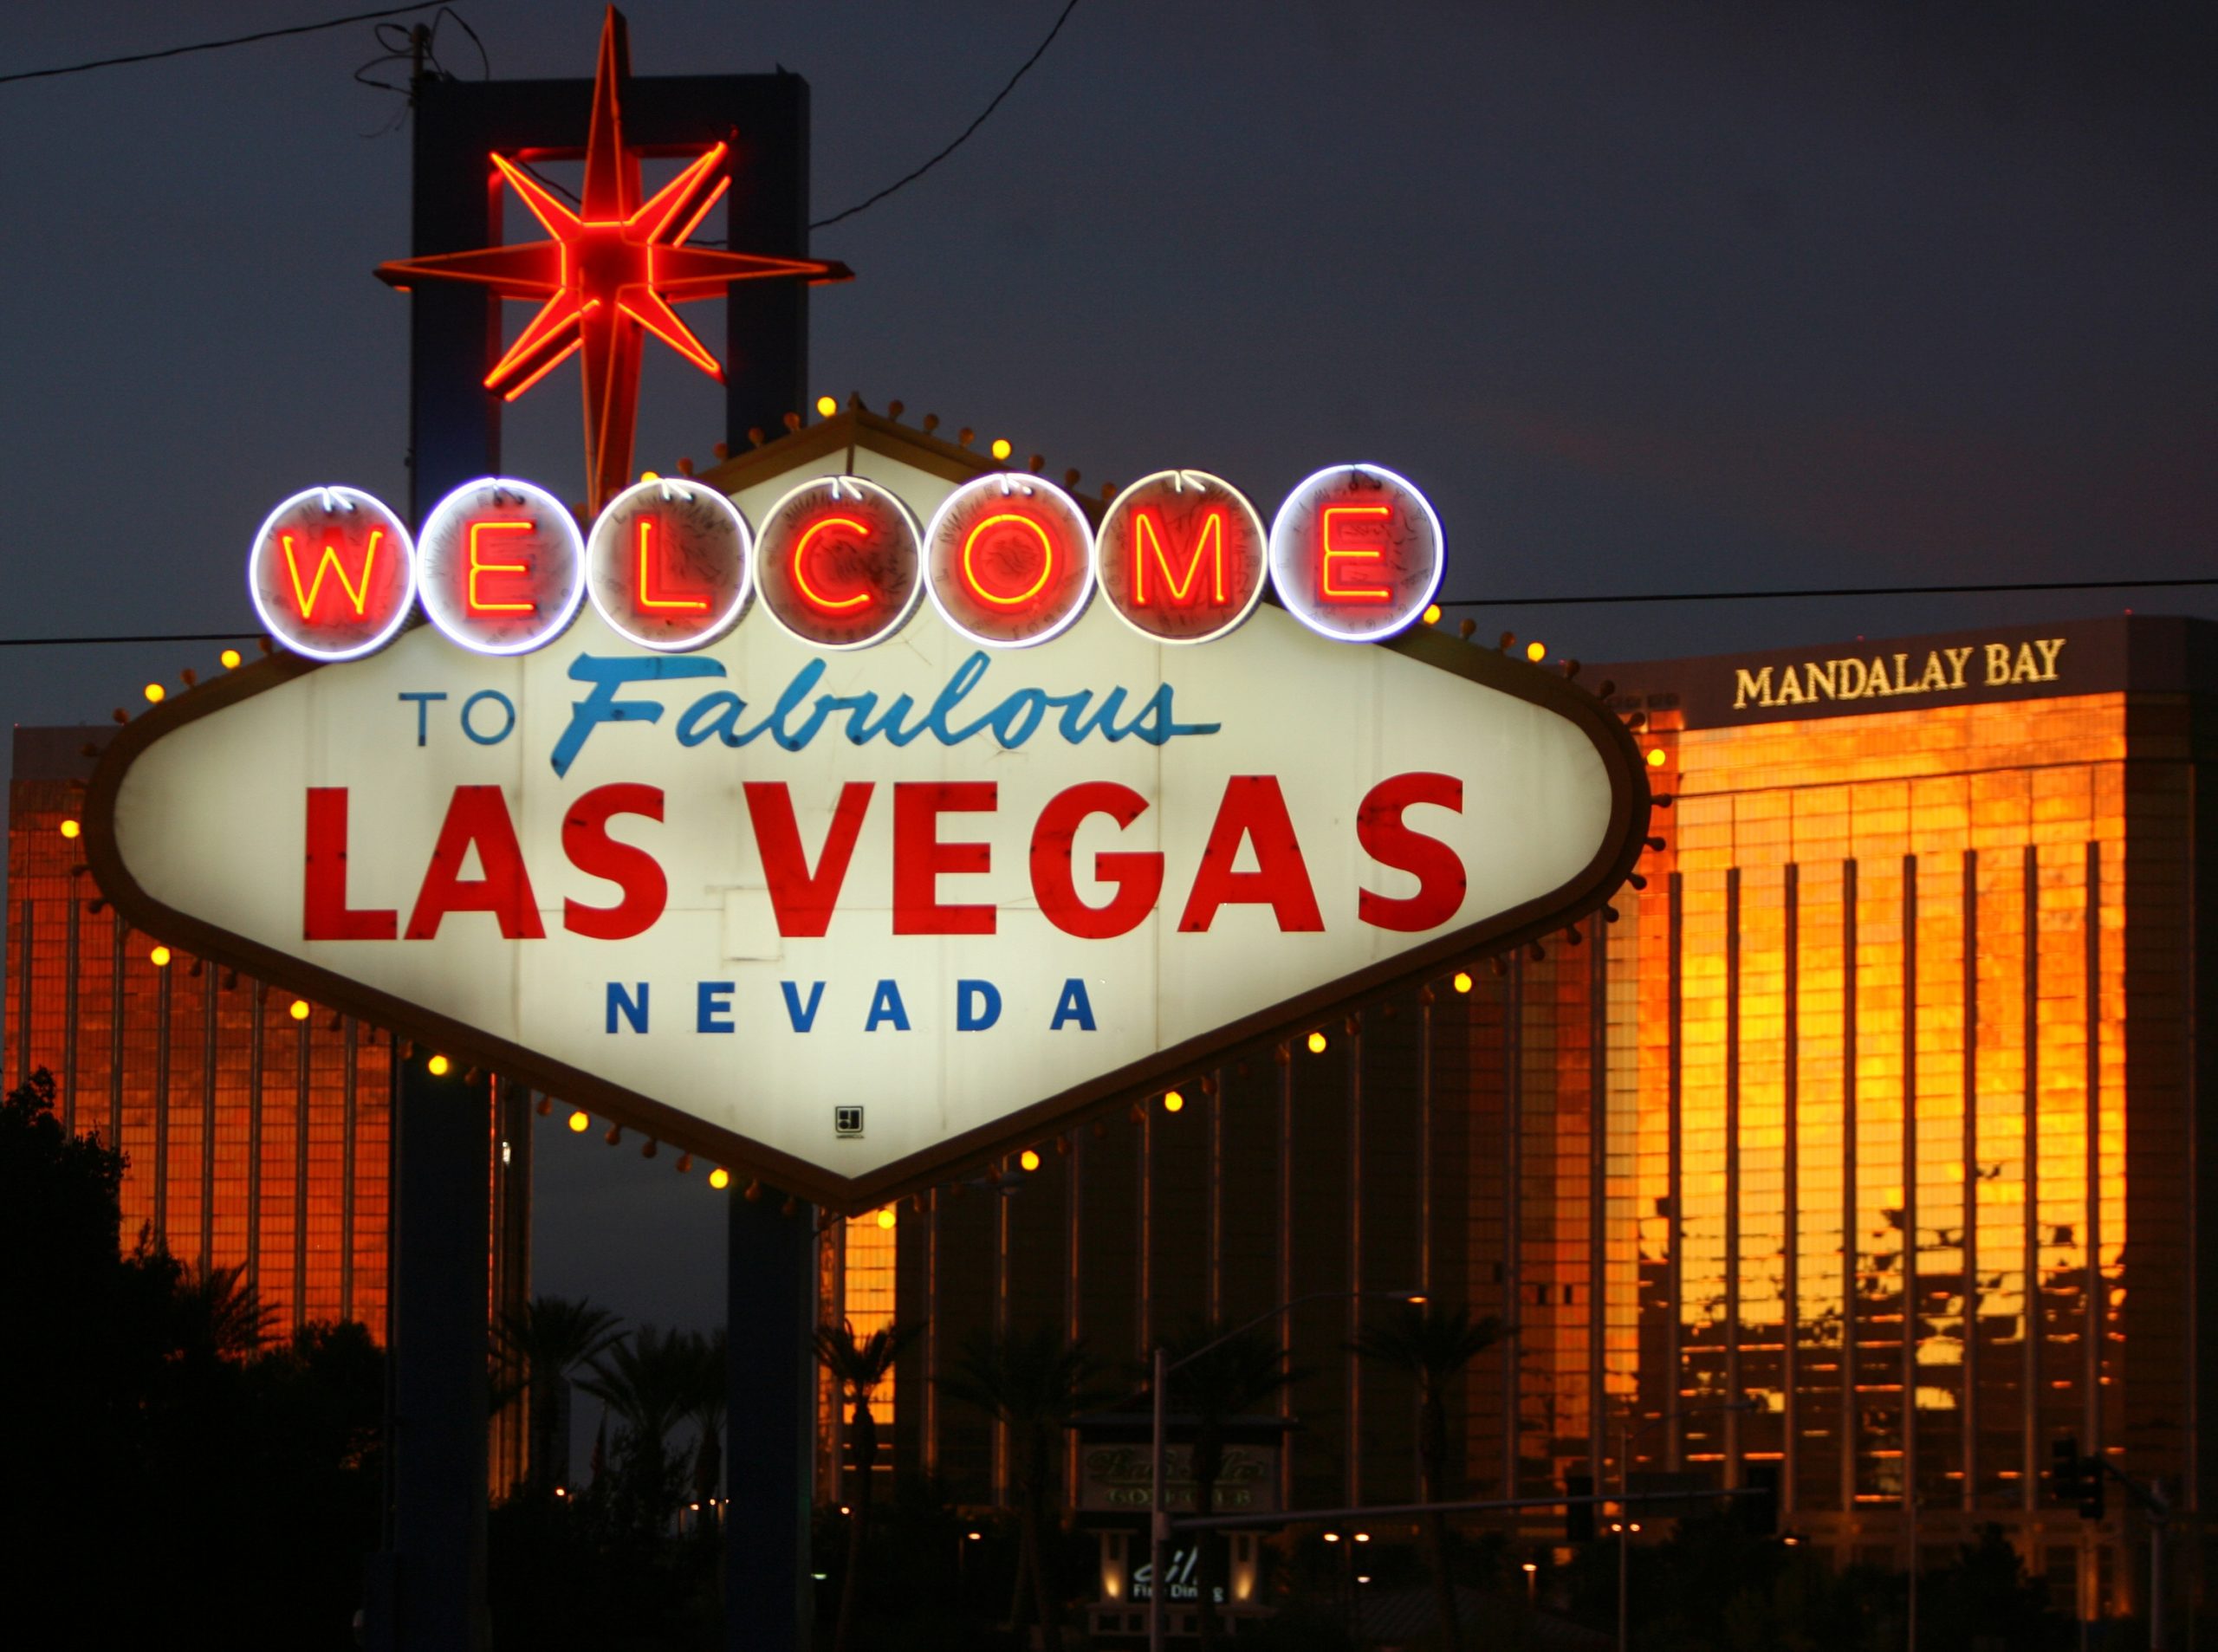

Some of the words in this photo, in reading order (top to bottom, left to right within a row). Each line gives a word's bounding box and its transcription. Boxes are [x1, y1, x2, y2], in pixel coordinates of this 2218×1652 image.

[276, 499, 1397, 625] WELCOME
[398, 690, 516, 747] TO
[549, 651, 1222, 779] Fabulous
[1733, 646, 1975, 709] MANDALAY
[1983, 638, 2067, 686] BAY
[303, 781, 669, 941] LAS
[742, 771, 1468, 940] VEGAS
[606, 979, 1098, 1034] NEVADA
